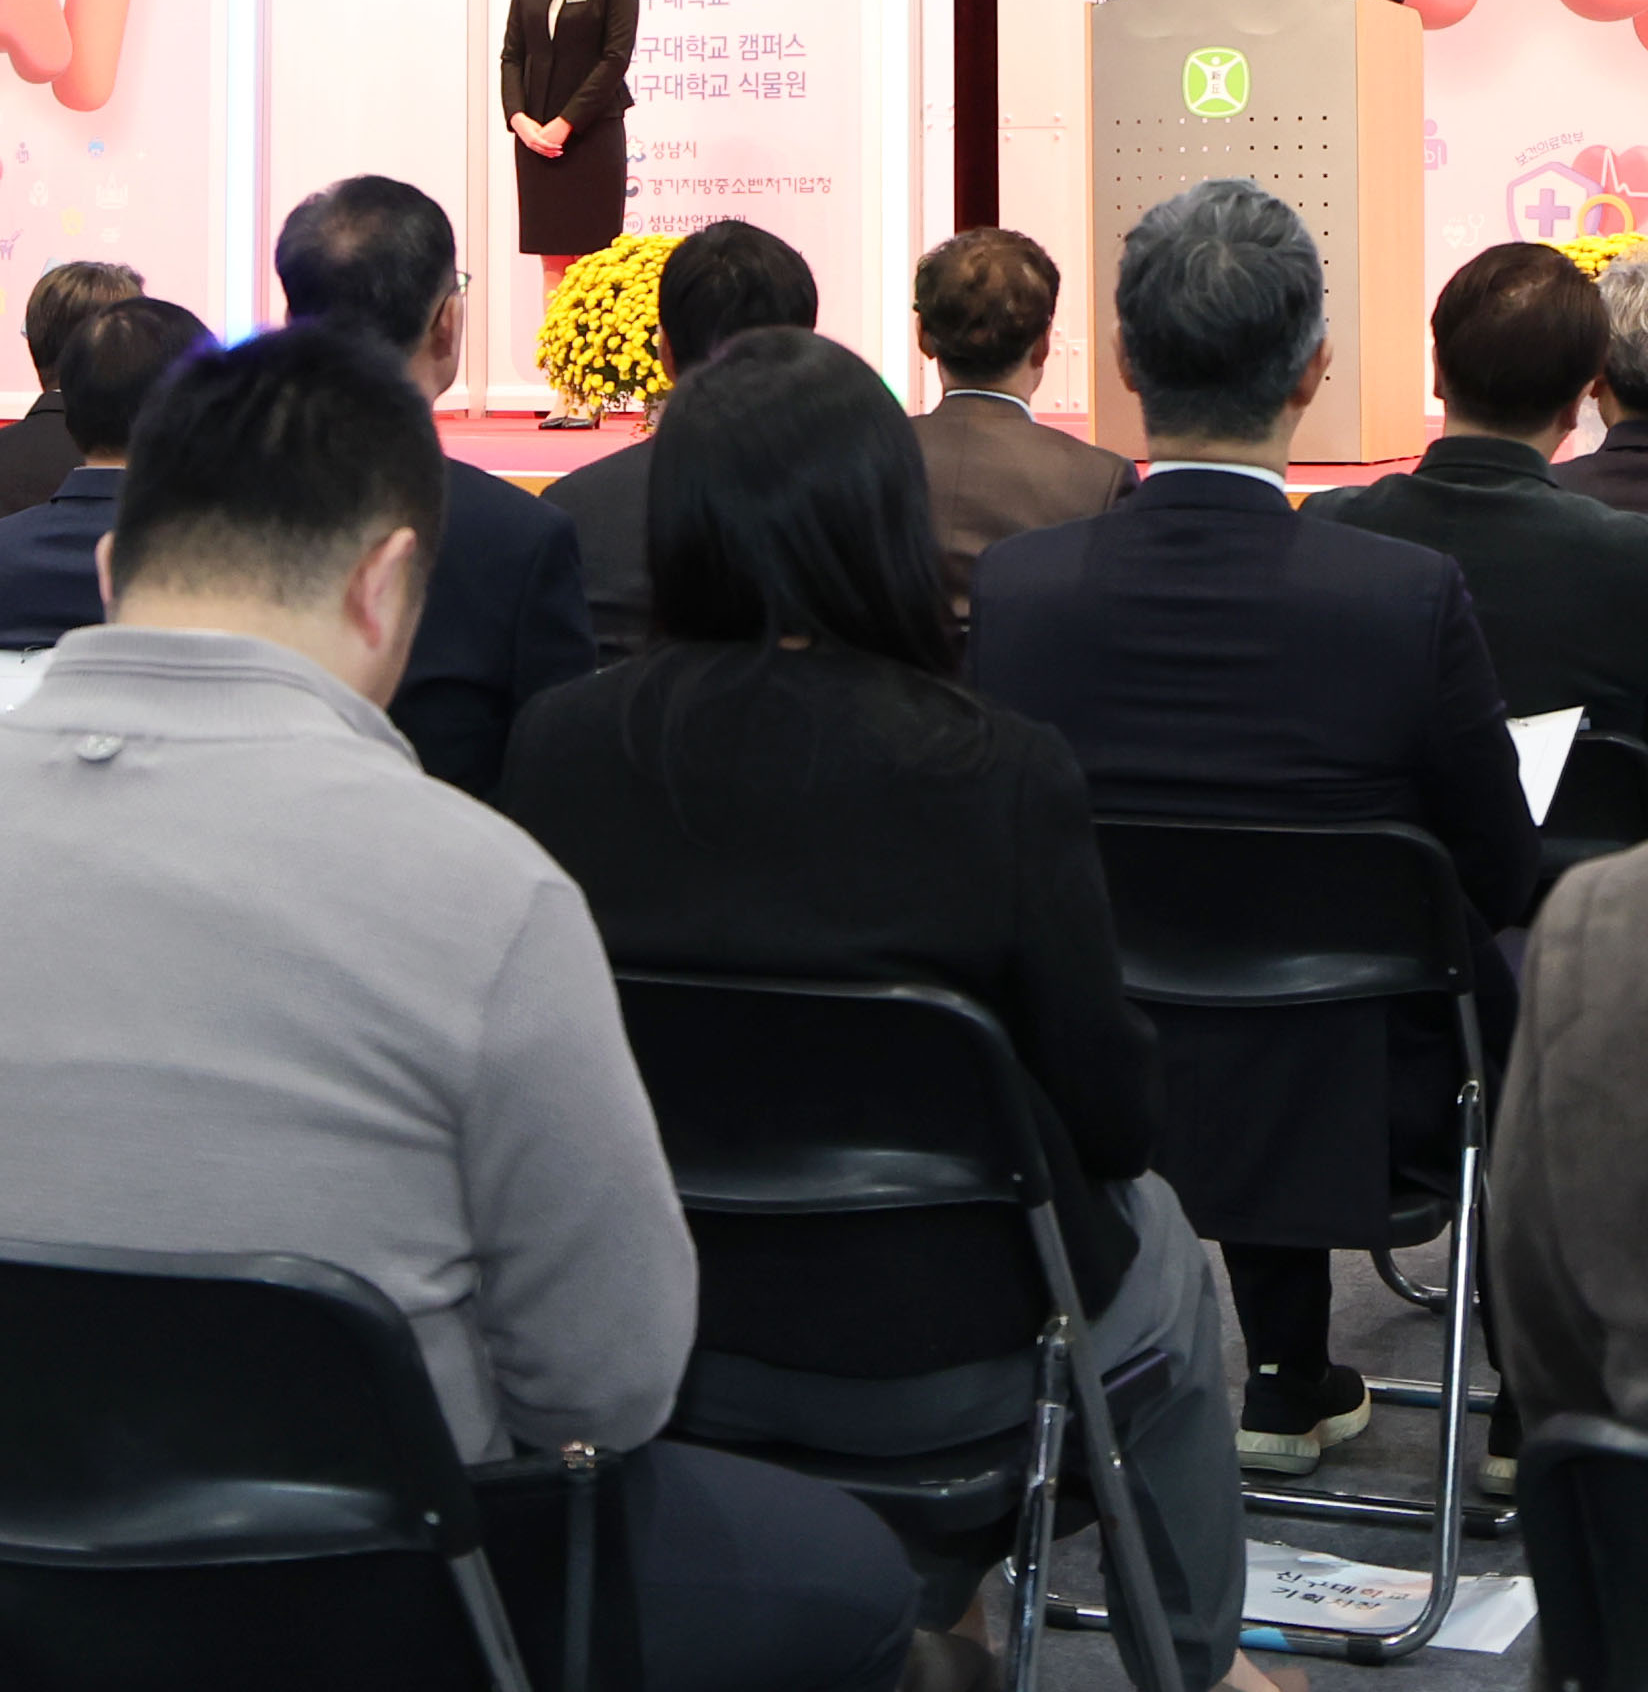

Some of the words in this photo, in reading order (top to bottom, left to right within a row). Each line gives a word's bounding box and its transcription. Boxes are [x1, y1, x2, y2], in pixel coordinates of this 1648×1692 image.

[629, 34, 731, 64] 구대학교
[737, 33, 808, 61] 캠퍼스
[737, 70, 808, 100] 식물원
[650, 140, 698, 160] 성남시
